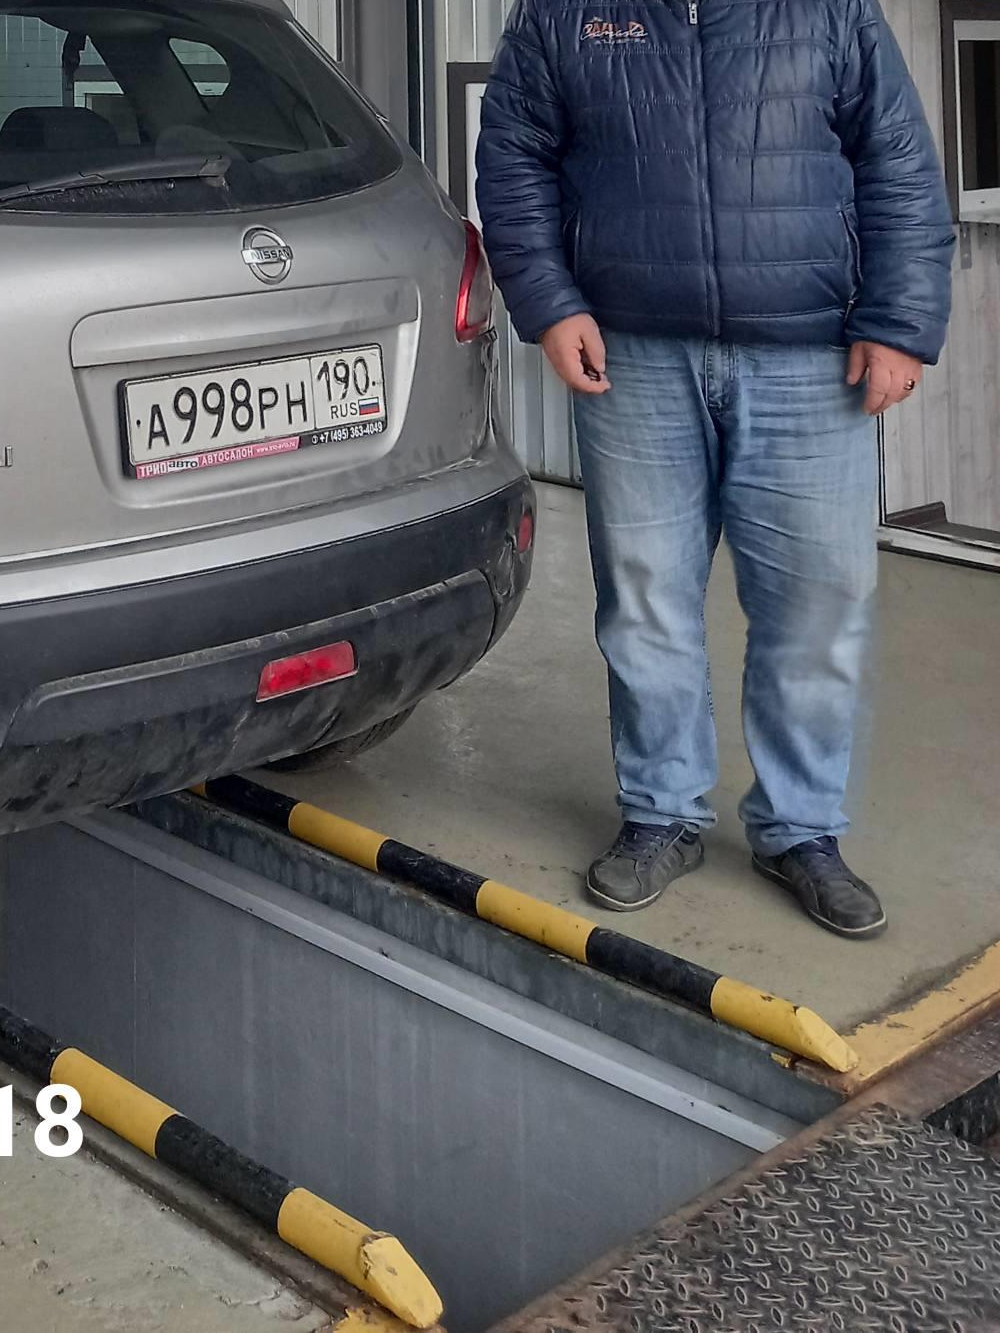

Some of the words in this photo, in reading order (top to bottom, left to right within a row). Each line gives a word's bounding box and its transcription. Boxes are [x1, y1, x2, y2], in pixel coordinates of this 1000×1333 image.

[250, 248, 290, 260] NISSAN
[147, 378, 308, 450] А998РН
[317, 356, 370, 402] 190
[330, 404, 359, 420] RUS
[331, 428, 349, 442] (495)
[201, 447, 254, 466] АВТОСАЛОН
